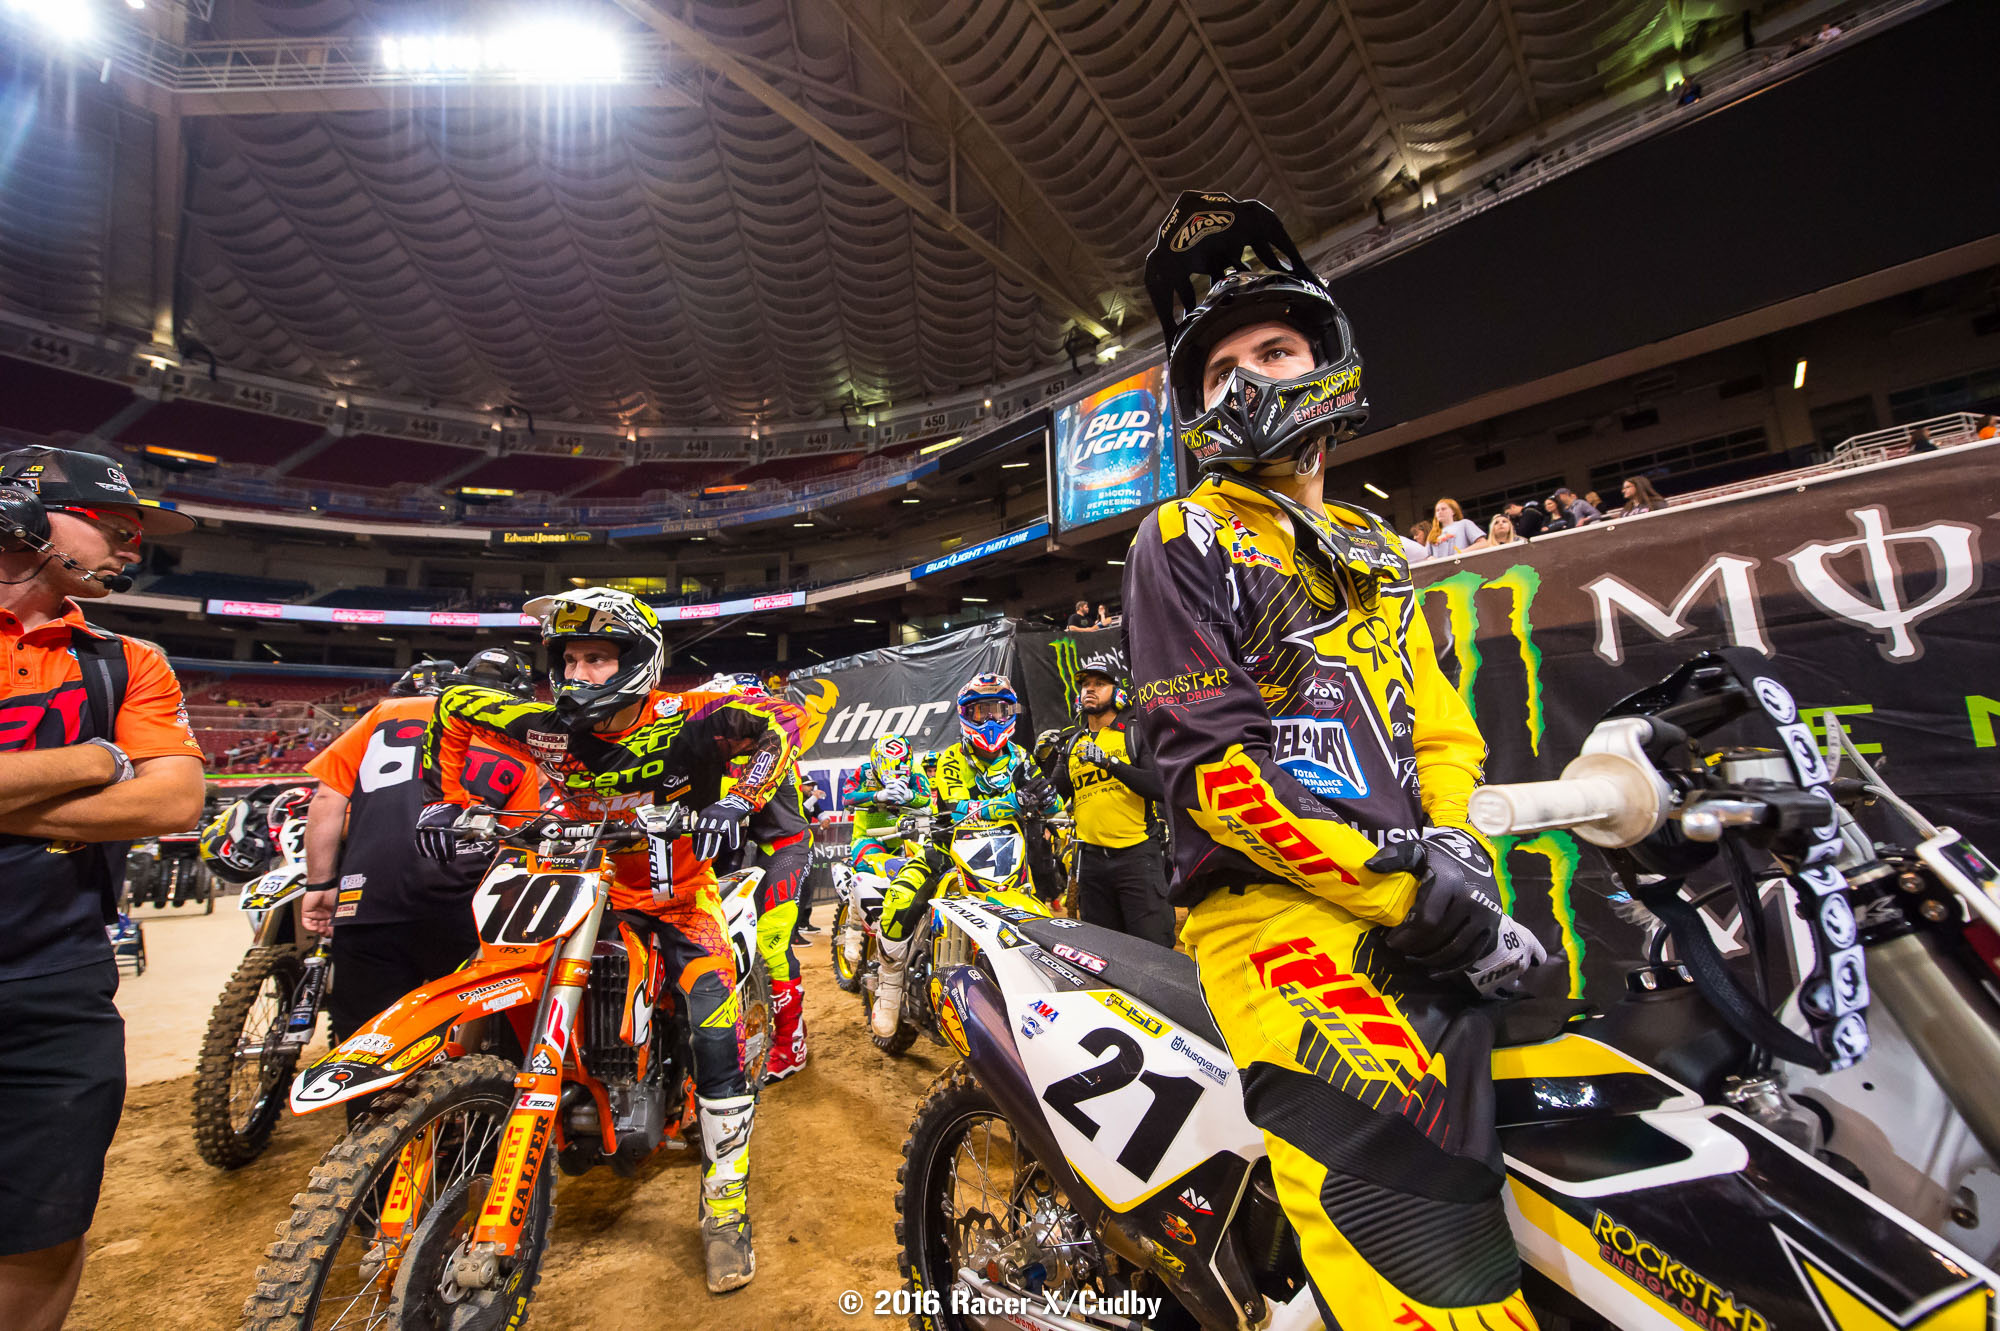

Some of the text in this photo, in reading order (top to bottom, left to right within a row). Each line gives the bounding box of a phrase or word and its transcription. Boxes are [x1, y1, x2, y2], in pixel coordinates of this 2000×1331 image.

[1178, 213, 1230, 249] Airoh
[924, 415, 945, 428] 450
[1262, 403, 1278, 435] Airoh
[1294, 391, 1356, 422] ENERGY DRINK
[1084, 411, 1150, 441] BUD
[1223, 424, 1243, 445] Airoh
[1071, 431, 1155, 466] LIGHT
[1087, 499, 1141, 509] REFRESHING
[1098, 489, 1134, 498] SMOOTH
[925, 531, 1029, 573] BUD LIGHT PARTY ZONE
[1348, 548, 1401, 568] ATLAS
[1146, 688, 1222, 712] ENERGY DRINK
[528, 732, 566, 743] BUBBA
[822, 701, 951, 744] thor
[1293, 769, 1319, 779] TOTAL
[1297, 778, 1343, 788] ORMANCE
[1311, 787, 1341, 796] CANTS
[967, 834, 1018, 877] 4
[480, 874, 586, 943] 10
[1503, 931, 1520, 950] 68
[1039, 956, 1085, 988] SCOSCHE
[1052, 943, 1109, 974] GUTS
[457, 977, 522, 1001] Palmetto
[1028, 1000, 1061, 1024] AMA
[1181, 1044, 1228, 1081] Husqvarna
[1042, 1027, 1206, 1184] 21
[485, 1126, 525, 1215] PIRELLI
[510, 1116, 550, 1227] GALFER
[1602, 1245, 1675, 1301] ENERGY
